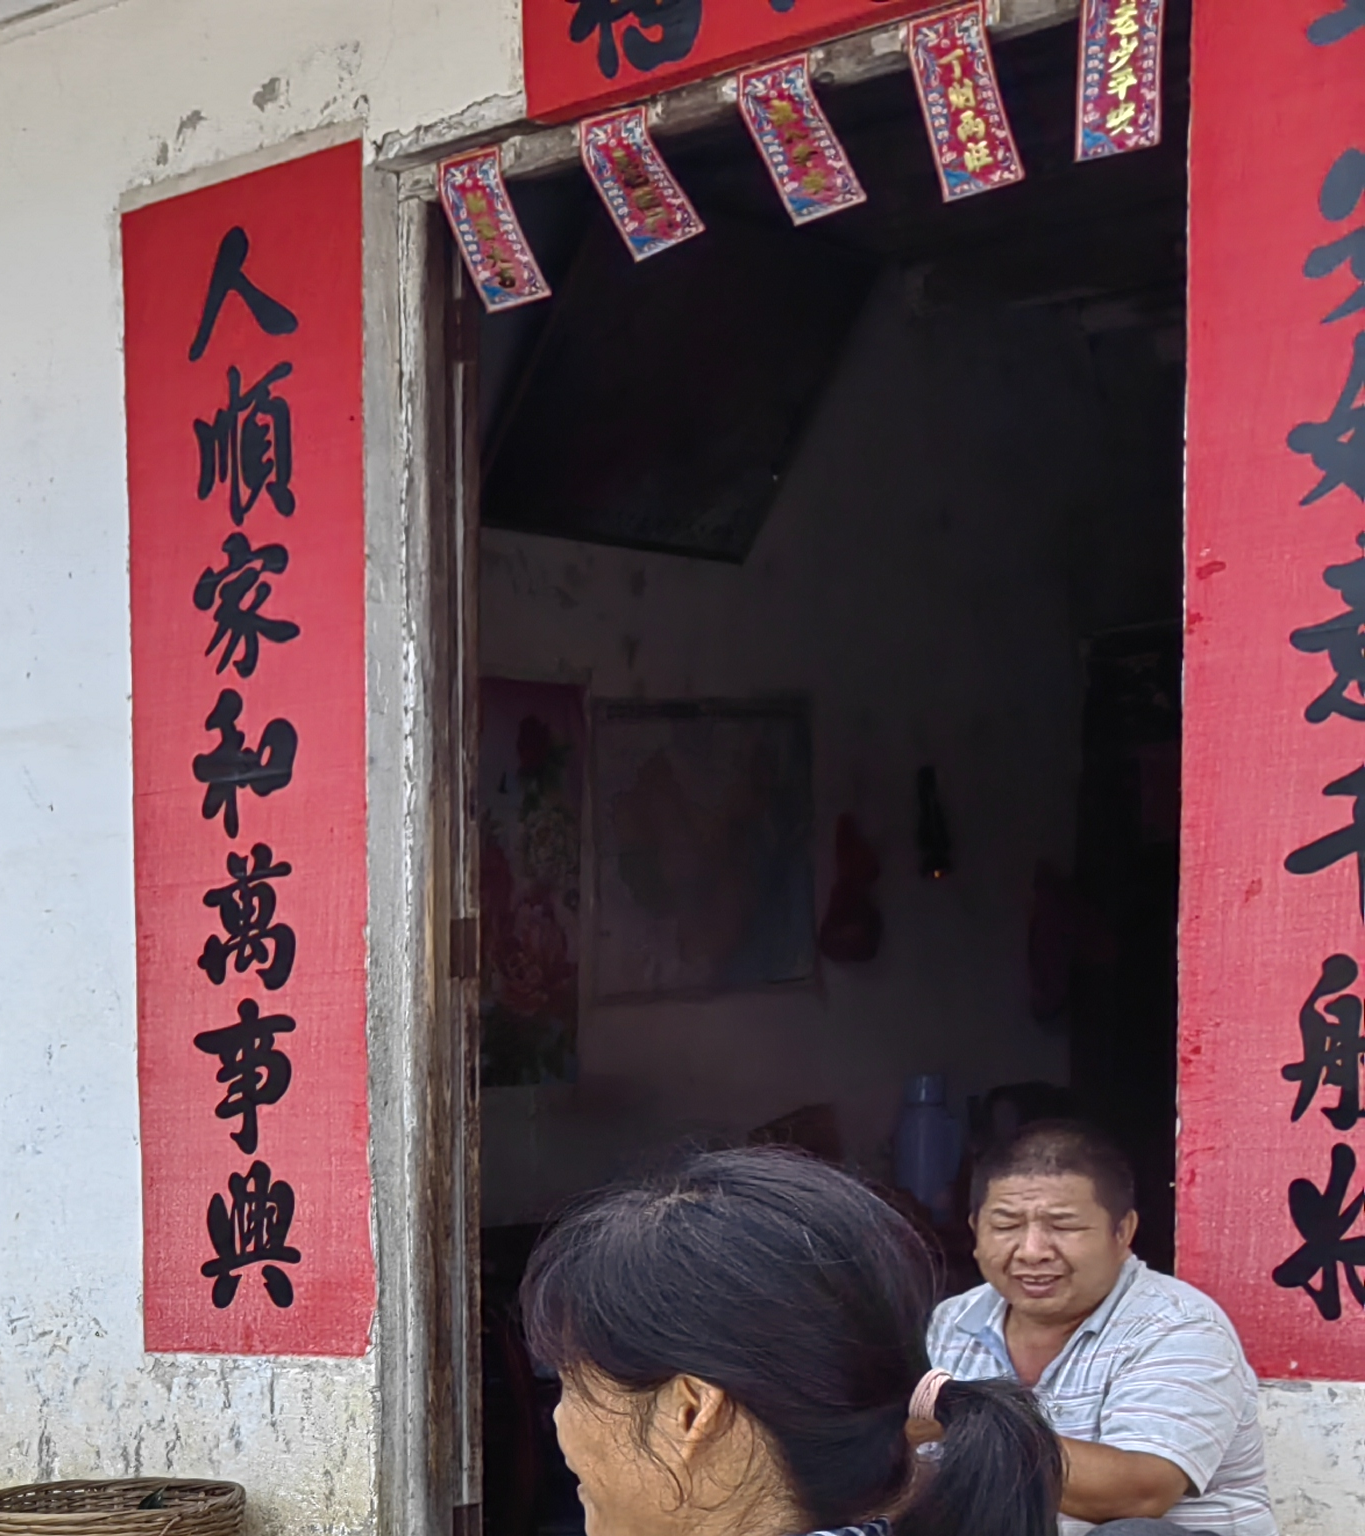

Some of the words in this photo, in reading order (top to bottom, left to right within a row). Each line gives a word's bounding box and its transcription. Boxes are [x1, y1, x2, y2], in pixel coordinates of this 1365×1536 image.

[188, 226, 302, 1309] 人順家和萬事興
